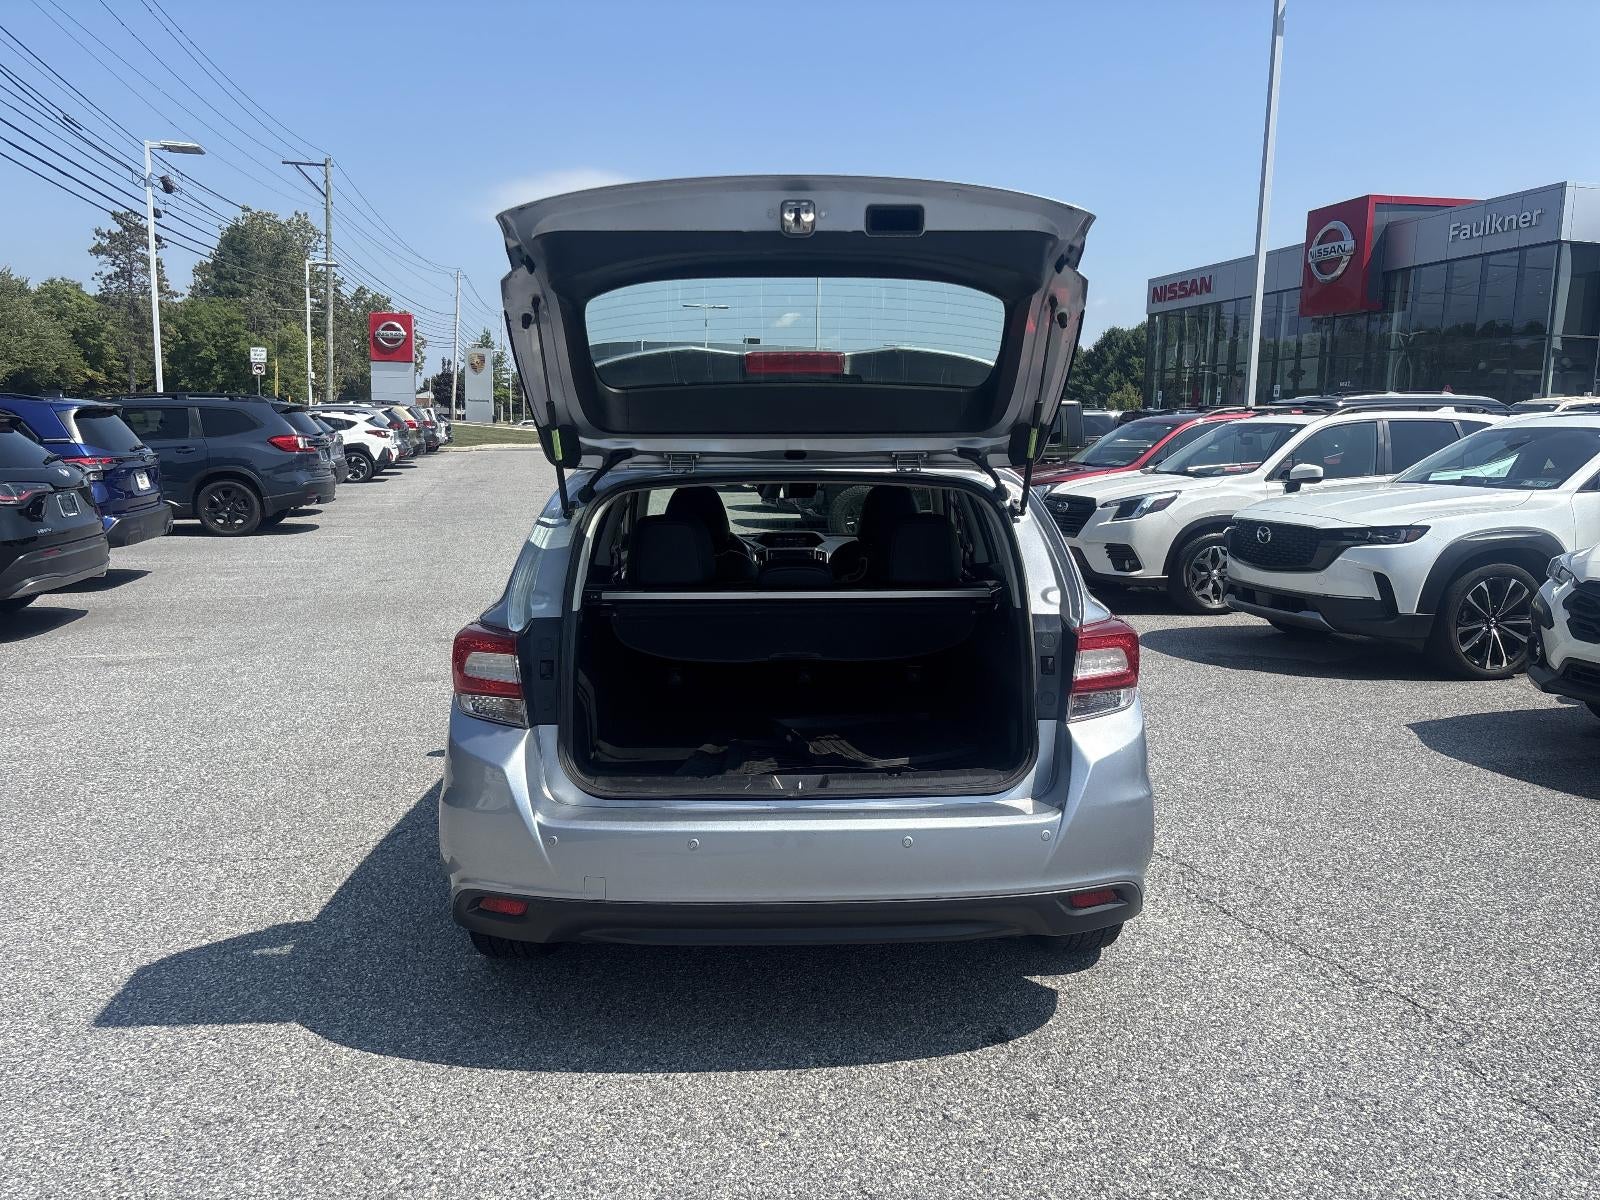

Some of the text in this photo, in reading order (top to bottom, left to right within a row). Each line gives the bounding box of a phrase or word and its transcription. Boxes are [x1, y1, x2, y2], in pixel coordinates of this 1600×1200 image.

[1448, 208, 1543, 242] Faulkner
[1309, 244, 1346, 260] NISSAN
[1152, 274, 1212, 304] NISSAN
